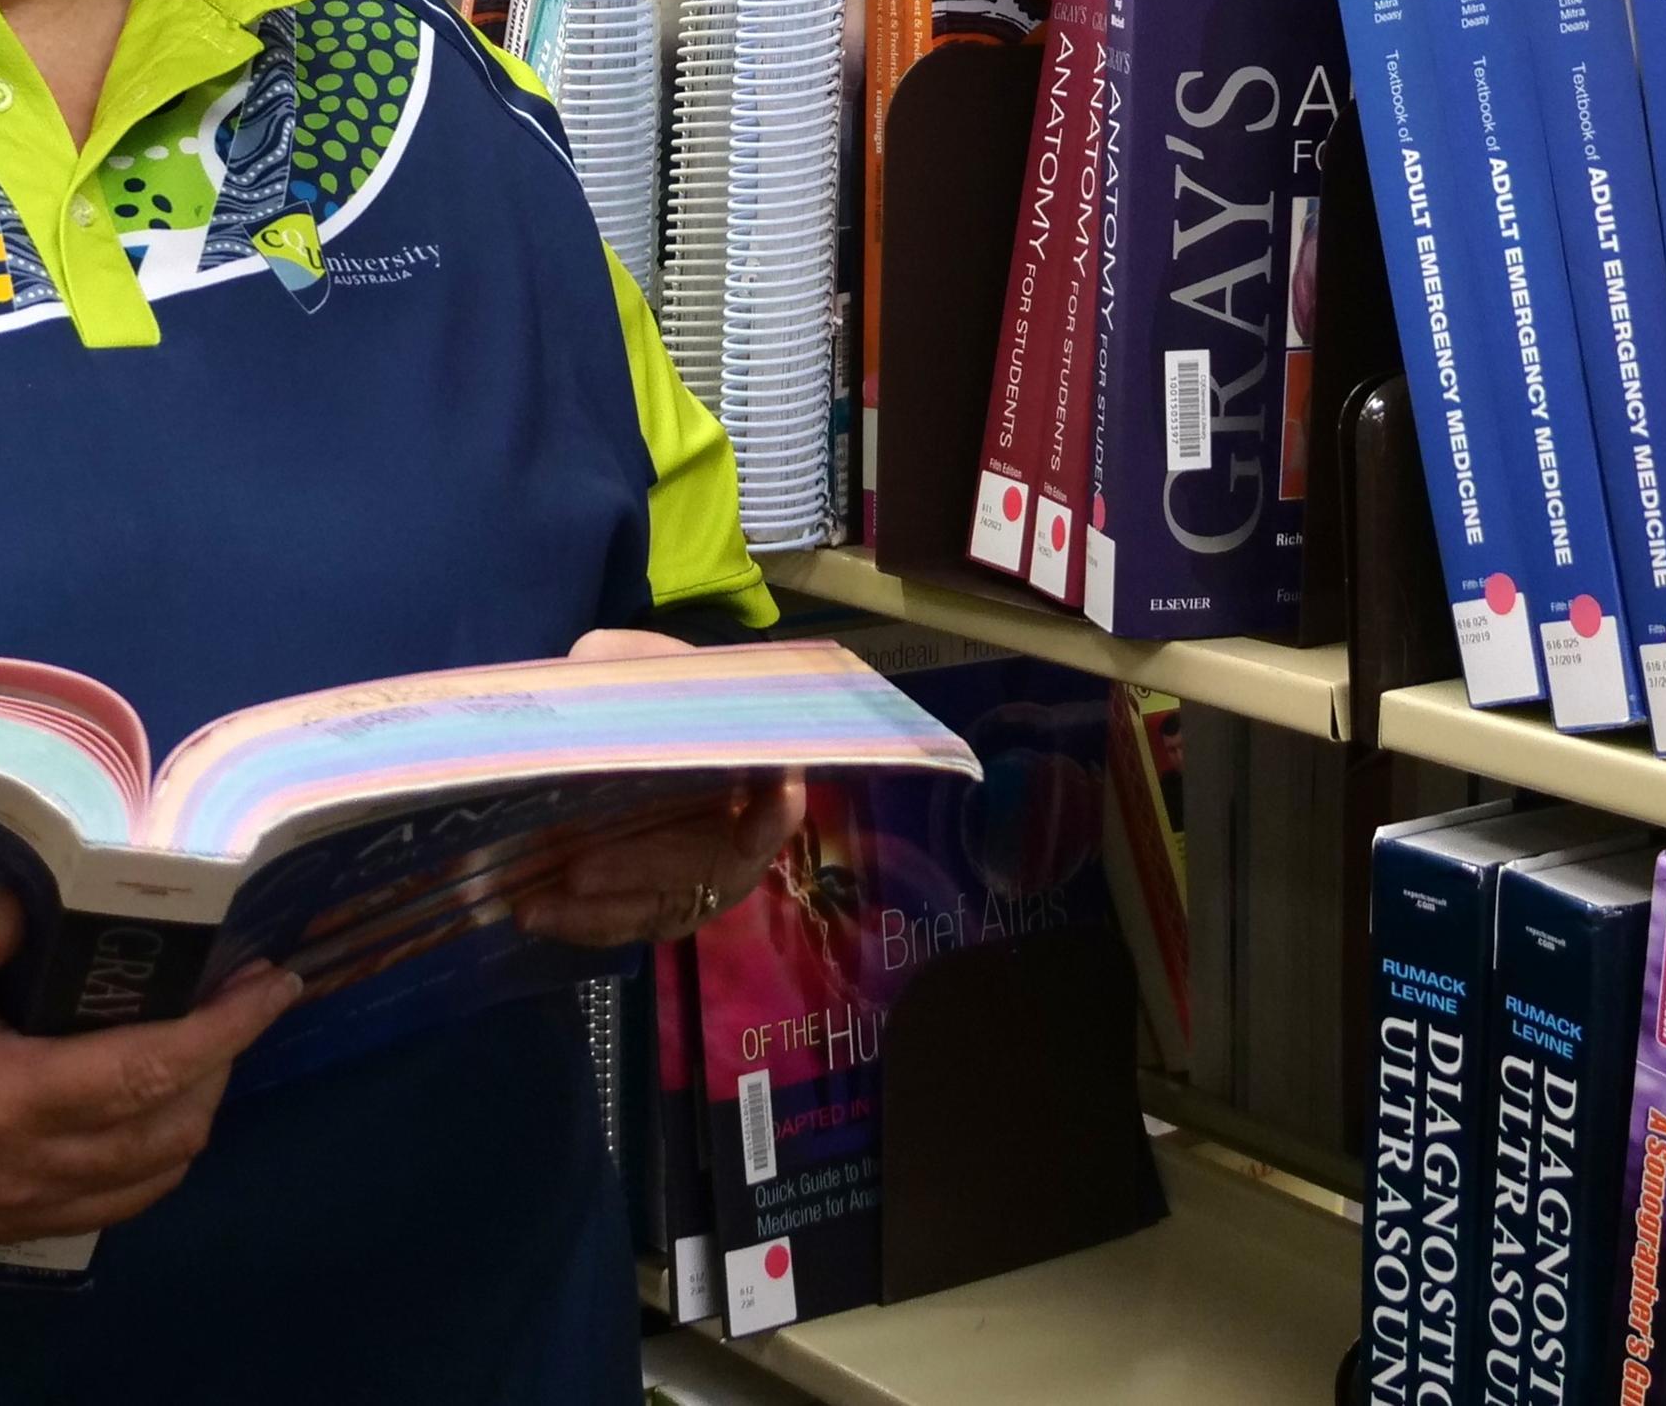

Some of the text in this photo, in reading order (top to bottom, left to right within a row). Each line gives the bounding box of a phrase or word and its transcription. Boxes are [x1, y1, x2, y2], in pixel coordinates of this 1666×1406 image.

[999, 31, 1075, 449] ANATOMY FOR STUDENTS
[333, 269, 413, 286] AUSTRALIA
[1384, 49, 1484, 547] Textbook of ADULT EMERGENCY MEDICINE
[1163, 64, 1281, 555] GRAY'S
[1150, 597, 1211, 612] ELSEVIER
[1382, 957, 1467, 996] RUMACK
[1390, 983, 1458, 1015] LEVINE
[741, 1012, 821, 1061] OF THE
